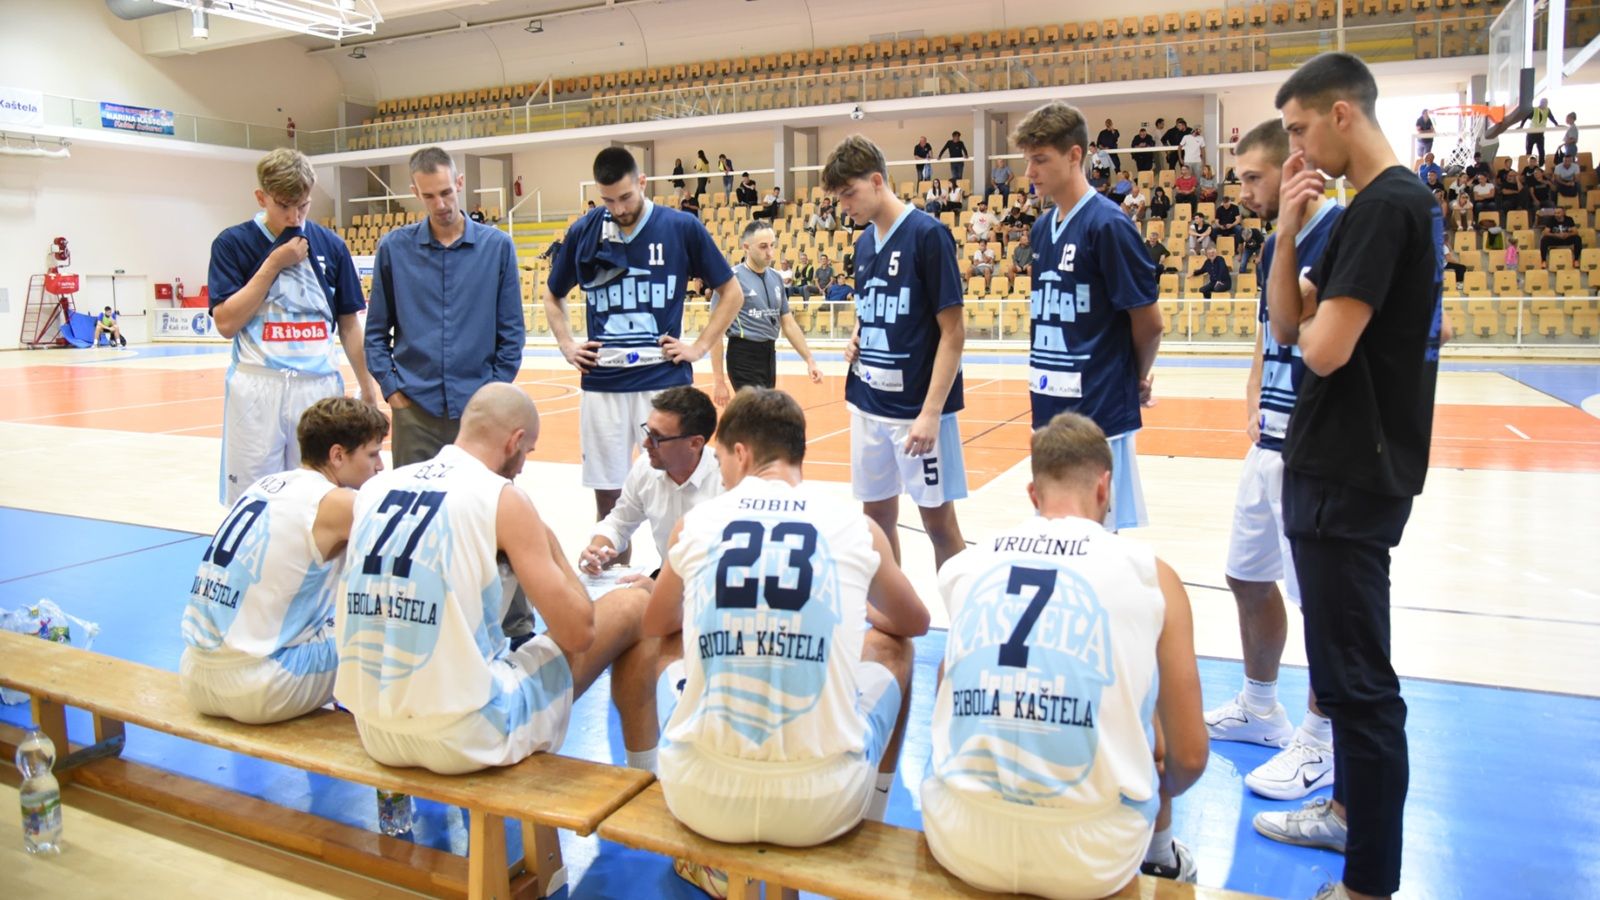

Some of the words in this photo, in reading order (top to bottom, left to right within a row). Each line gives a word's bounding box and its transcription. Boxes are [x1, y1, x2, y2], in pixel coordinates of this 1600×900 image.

[648, 243, 665, 266] 11
[888, 251, 901, 276] 5
[1057, 243, 1076, 272] 12
[271, 326, 325, 339] Ribola
[922, 457, 939, 487] 5
[737, 498, 807, 512] SOBIN
[202, 495, 267, 568] 10
[362, 489, 448, 578] 77
[994, 534, 1091, 556] VRUČINIĆ
[715, 520, 818, 612] 23
[347, 592, 382, 616] IBOLA
[387, 591, 438, 626] AŠTELA
[997, 565, 1057, 668] 7
[757, 626, 825, 663] KAŠTELA
[953, 689, 1001, 717] RIBOLA
[1013, 688, 1094, 729] KAŠTELA
